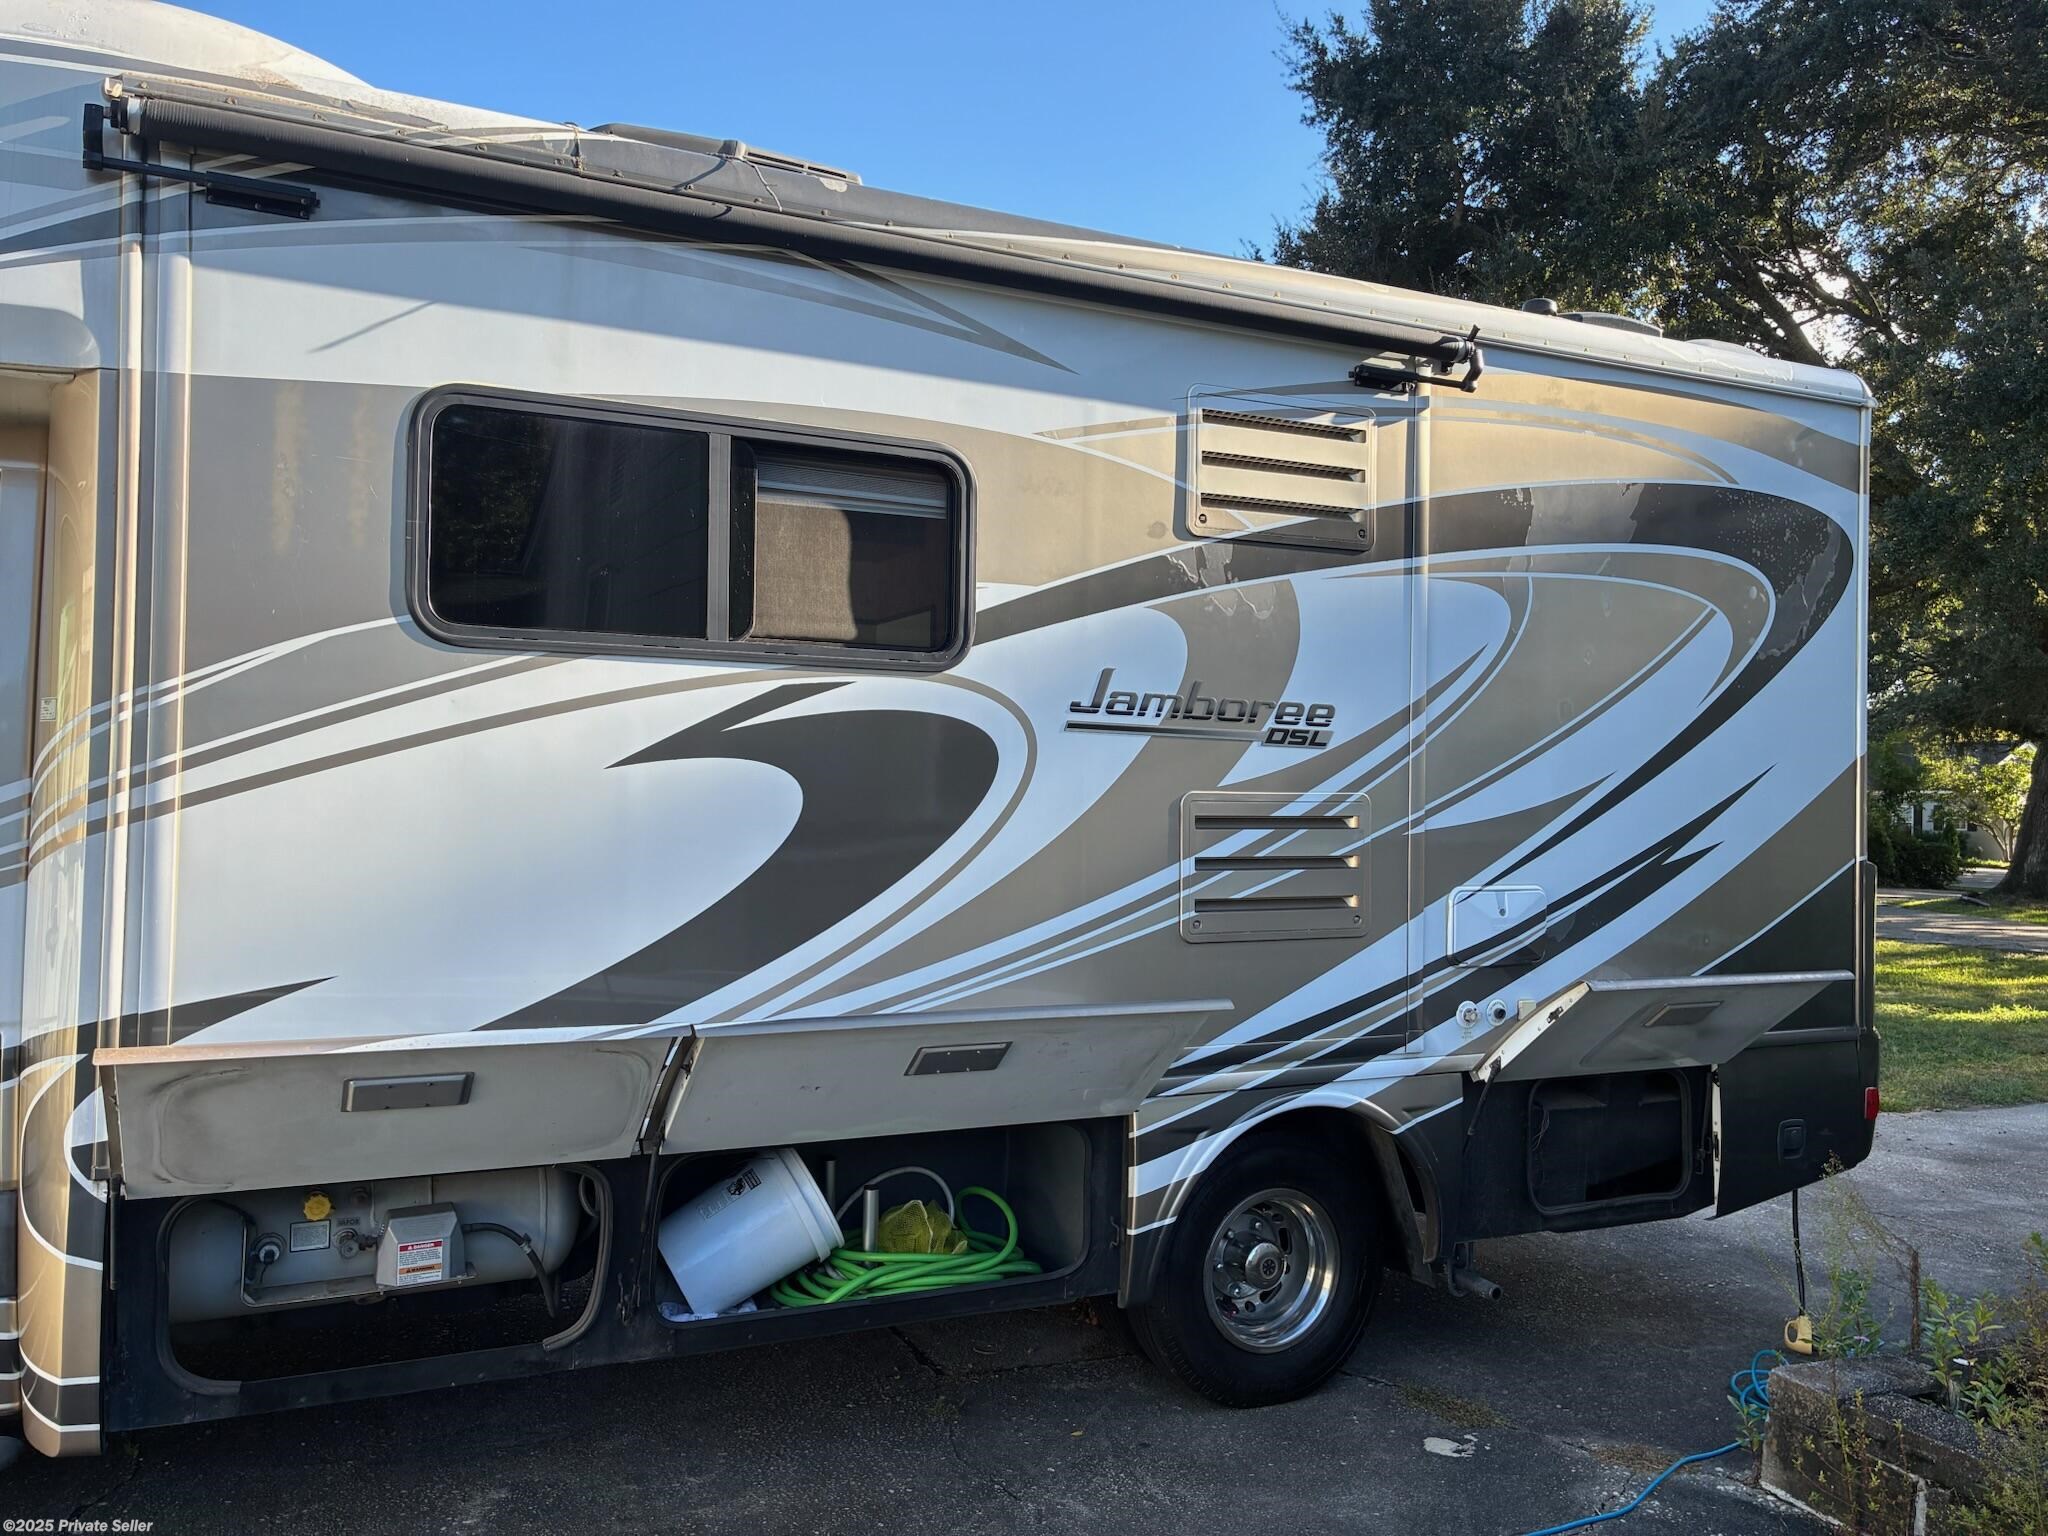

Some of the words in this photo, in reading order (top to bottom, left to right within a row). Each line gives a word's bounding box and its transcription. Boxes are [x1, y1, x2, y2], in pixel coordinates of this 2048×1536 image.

[1069, 667, 1336, 727] Jamboree
[1264, 729, 1329, 746] DSL
[413, 1242, 435, 1250] DANGER
